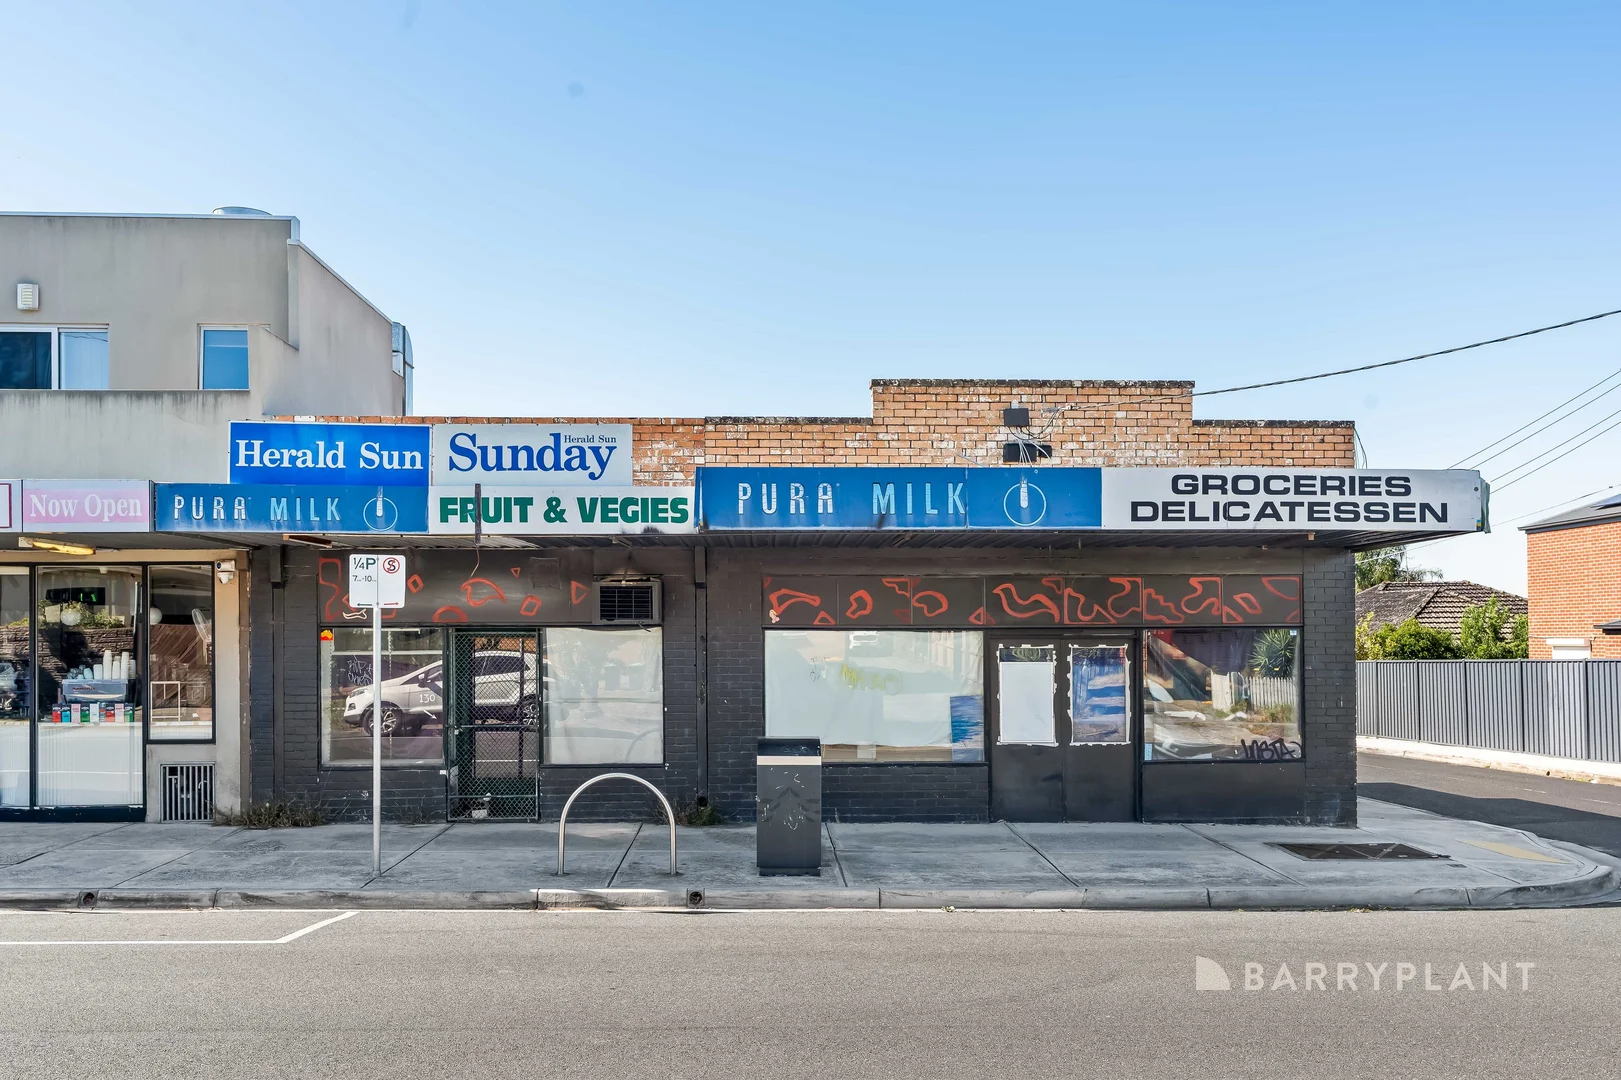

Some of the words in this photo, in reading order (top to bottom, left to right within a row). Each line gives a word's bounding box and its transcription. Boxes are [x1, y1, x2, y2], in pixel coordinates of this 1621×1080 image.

[563, 434, 595, 444] Herald
[598, 434, 617, 444] Sun
[235, 439, 346, 469] Herald
[359, 441, 424, 470] Sun
[449, 432, 617, 481] Sunday
[737, 482, 834, 515] PURA
[872, 482, 967, 515] MILK
[1171, 474, 1412, 497] GROCERIES
[30, 494, 79, 518] Now
[84, 493, 143, 522] Open
[174, 495, 247, 520] PURA
[270, 497, 341, 522] MILK
[439, 497, 534, 524] FRUIT
[543, 497, 568, 524] &
[577, 497, 689, 524] VEGIES
[1130, 500, 1448, 524] DELICATESSEN
[419, 693, 436, 704] 130
